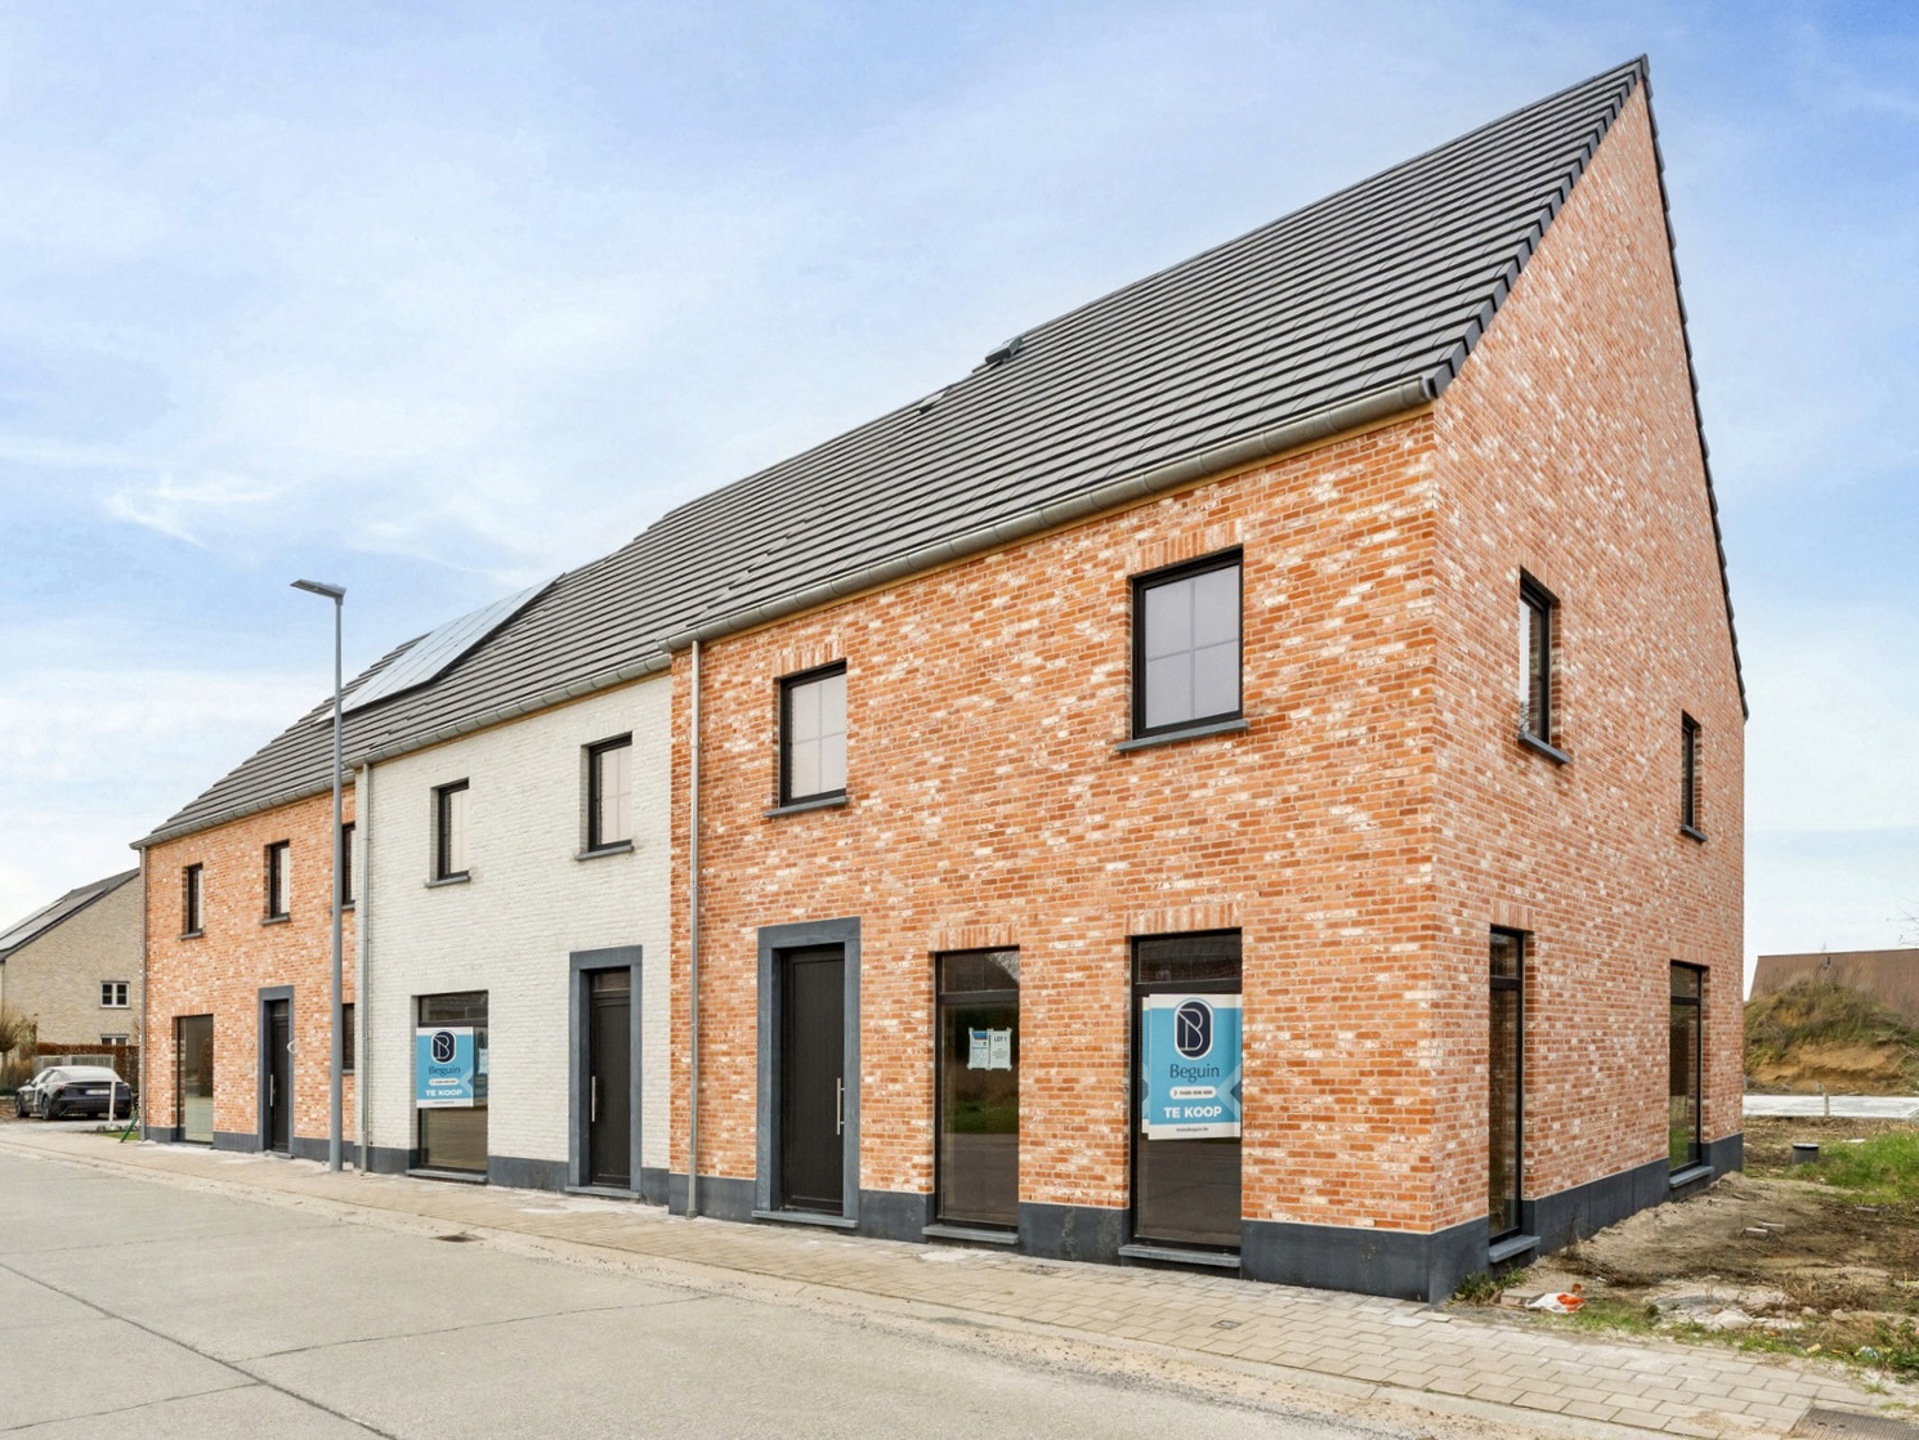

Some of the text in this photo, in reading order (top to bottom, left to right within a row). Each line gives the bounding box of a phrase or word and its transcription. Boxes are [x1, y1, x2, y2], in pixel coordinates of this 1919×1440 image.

[428, 1066, 461, 1077] Beguin
[1169, 1063, 1220, 1083] Beguin
[425, 1089, 436, 1097] TE
[1164, 1106, 1222, 1119] TE KOOP
